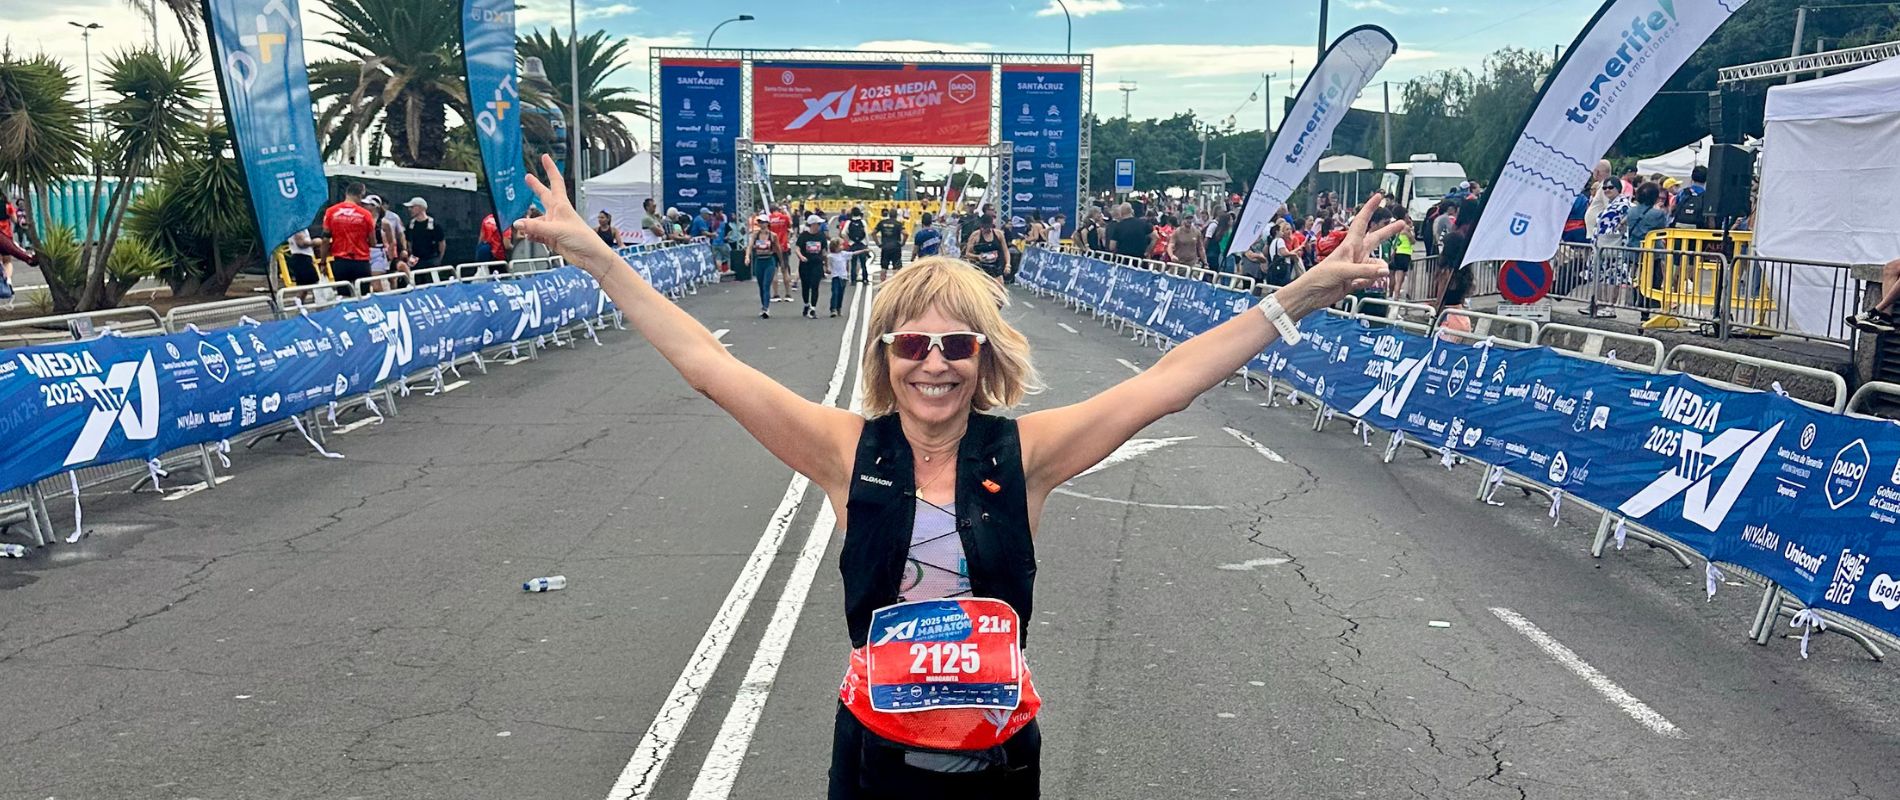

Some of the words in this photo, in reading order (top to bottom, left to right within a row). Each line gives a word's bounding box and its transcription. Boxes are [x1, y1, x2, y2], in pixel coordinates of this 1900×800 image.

[860, 85, 892, 100] 2025
[1017, 82, 1064, 90] SANTACRUZ
[783, 84, 857, 130] XI
[852, 92, 944, 116] MARATÓN
[1587, 79, 1627, 131] despierta
[40, 381, 85, 407] 2025
[1643, 425, 1682, 457] 2025
[1833, 459, 1864, 480] DADO
[1741, 523, 1780, 551] NIVARIA
[920, 616, 941, 627] 2025
[909, 642, 980, 674] 2125
